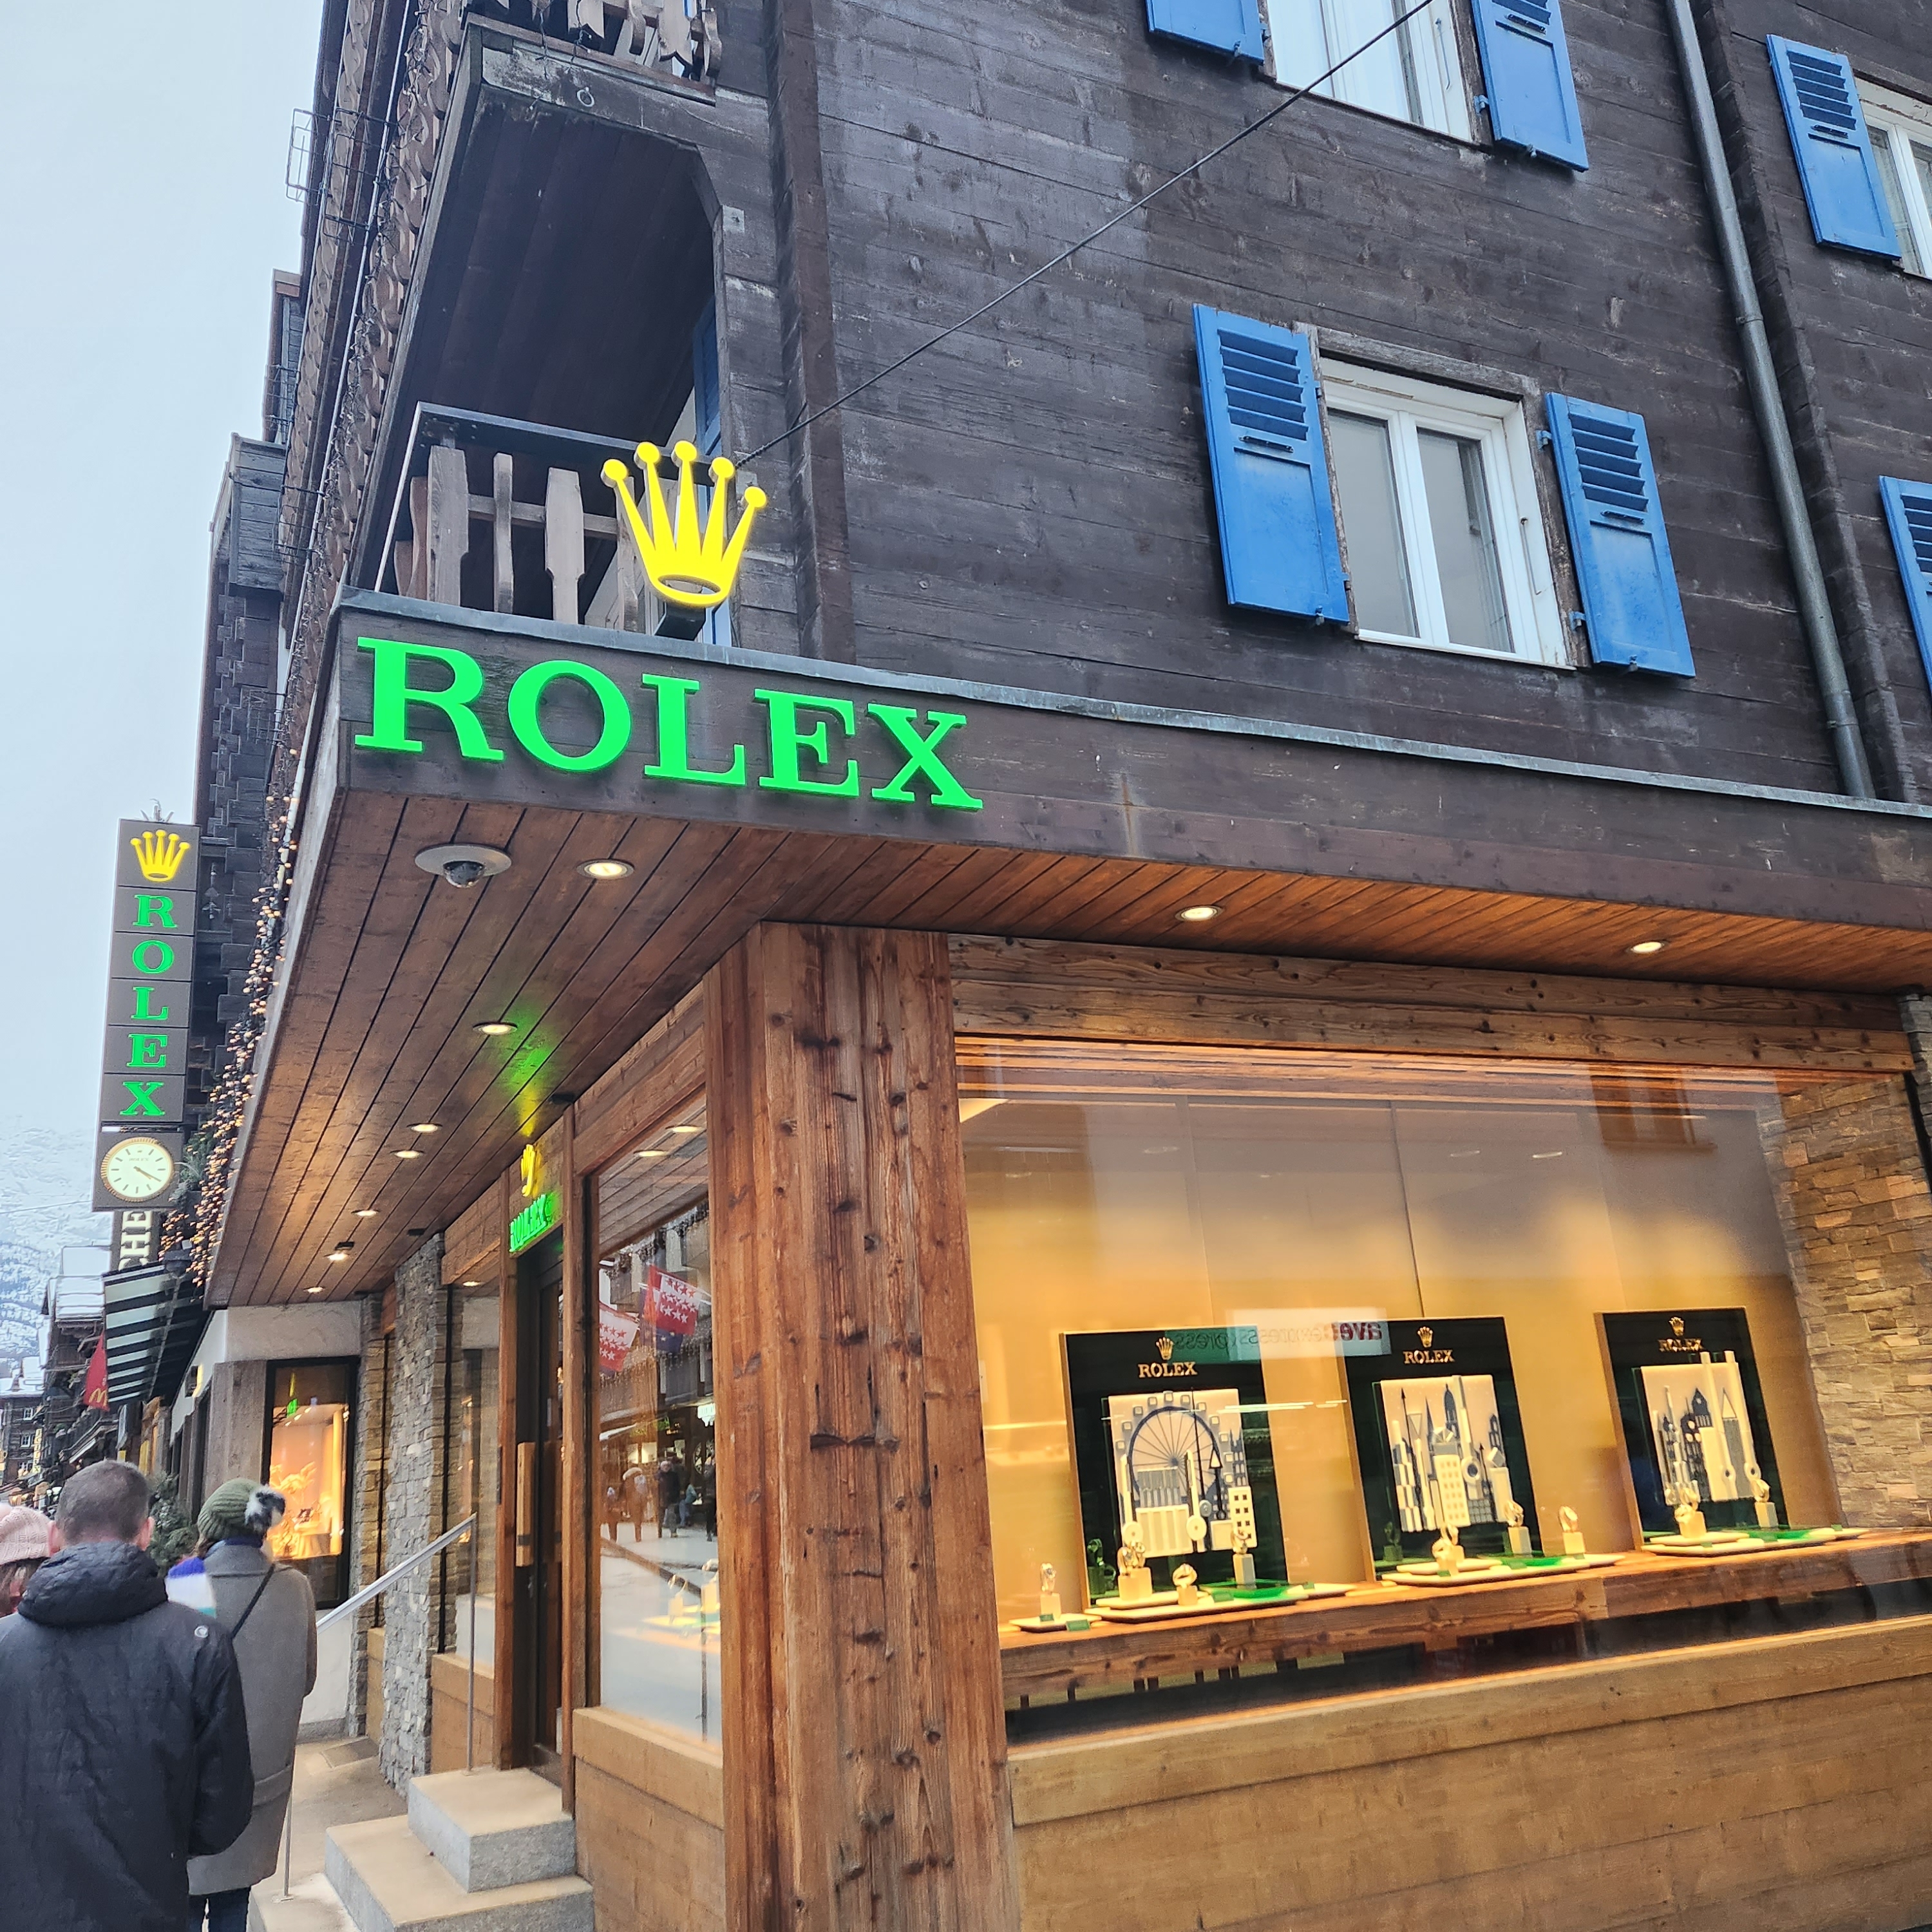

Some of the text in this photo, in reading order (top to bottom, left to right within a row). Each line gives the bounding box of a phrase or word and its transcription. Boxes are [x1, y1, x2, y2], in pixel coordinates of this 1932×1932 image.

[356, 638, 982, 810] ROLEX
[120, 895, 178, 1116] ROLEX
[1137, 1361, 1198, 1378] ROLEX
[1402, 1349, 1455, 1364] ROLEX
